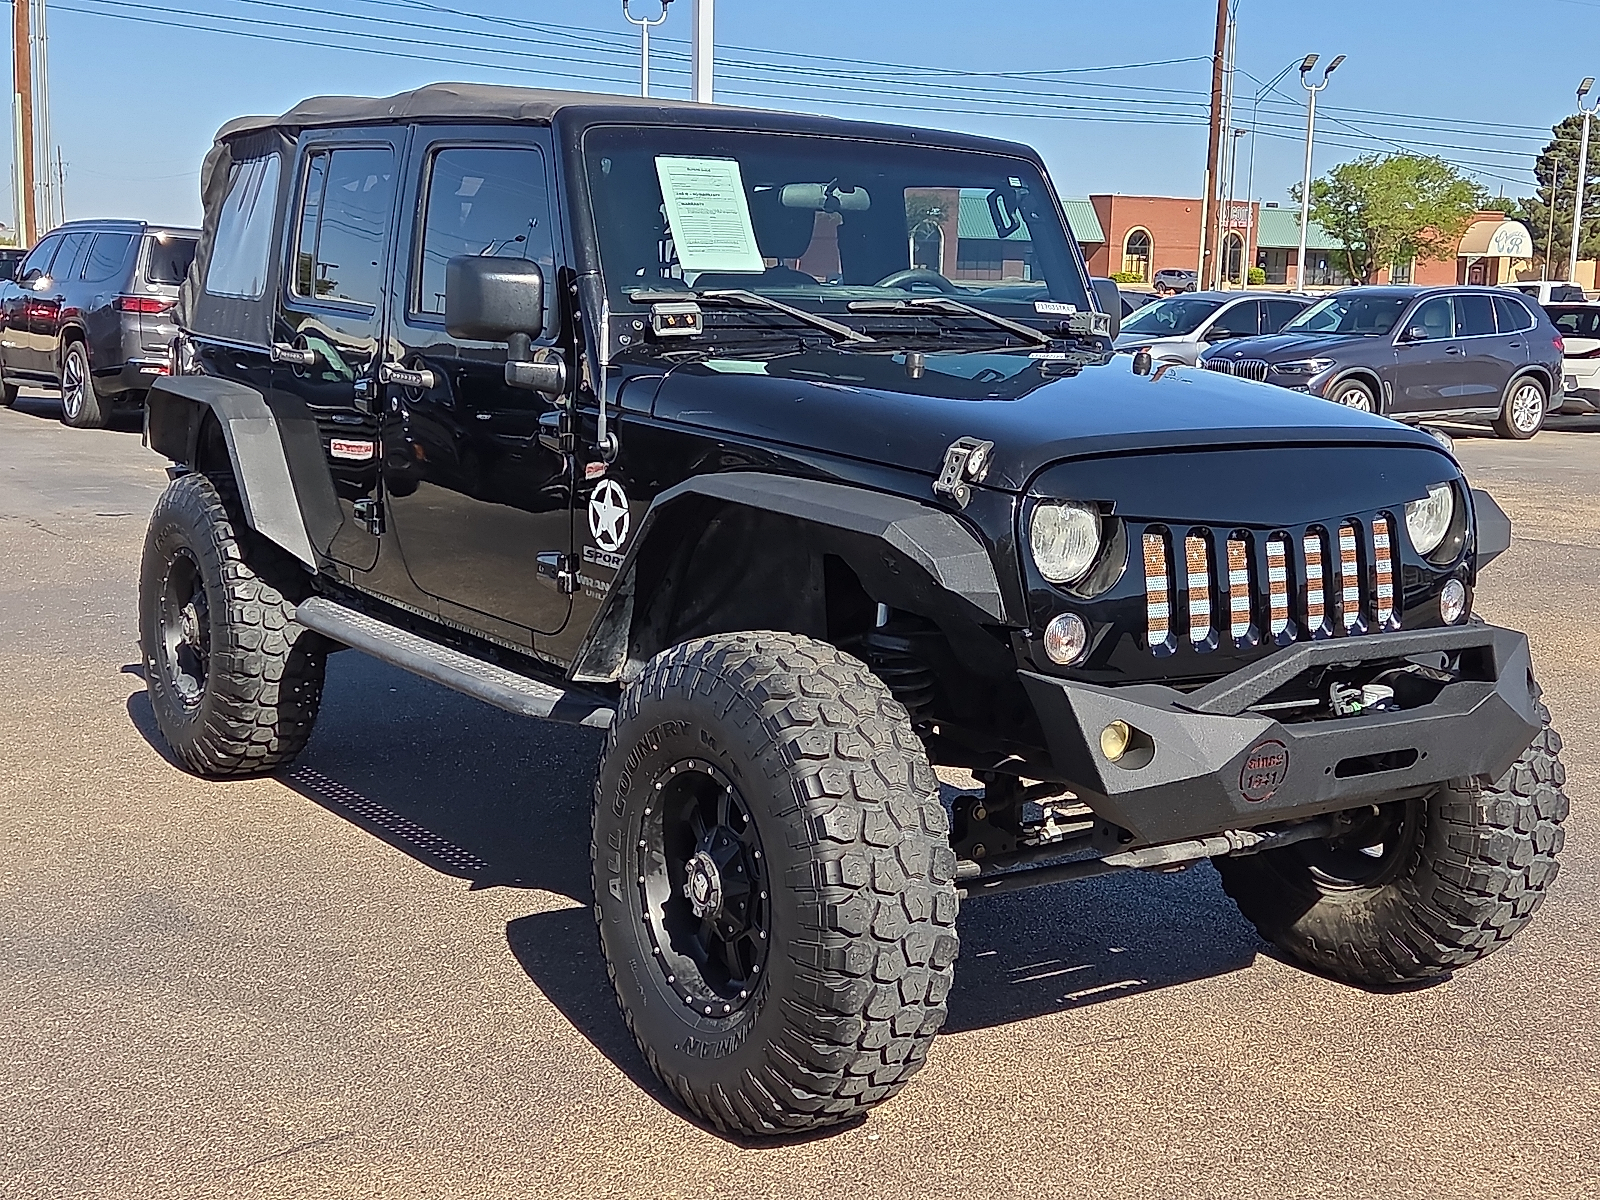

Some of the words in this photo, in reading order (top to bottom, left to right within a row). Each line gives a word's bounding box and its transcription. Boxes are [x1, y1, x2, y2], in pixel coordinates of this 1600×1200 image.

[586, 549, 624, 566] SPOR
[576, 574, 611, 591] WRAN
[612, 719, 692, 818] COUNTRY
